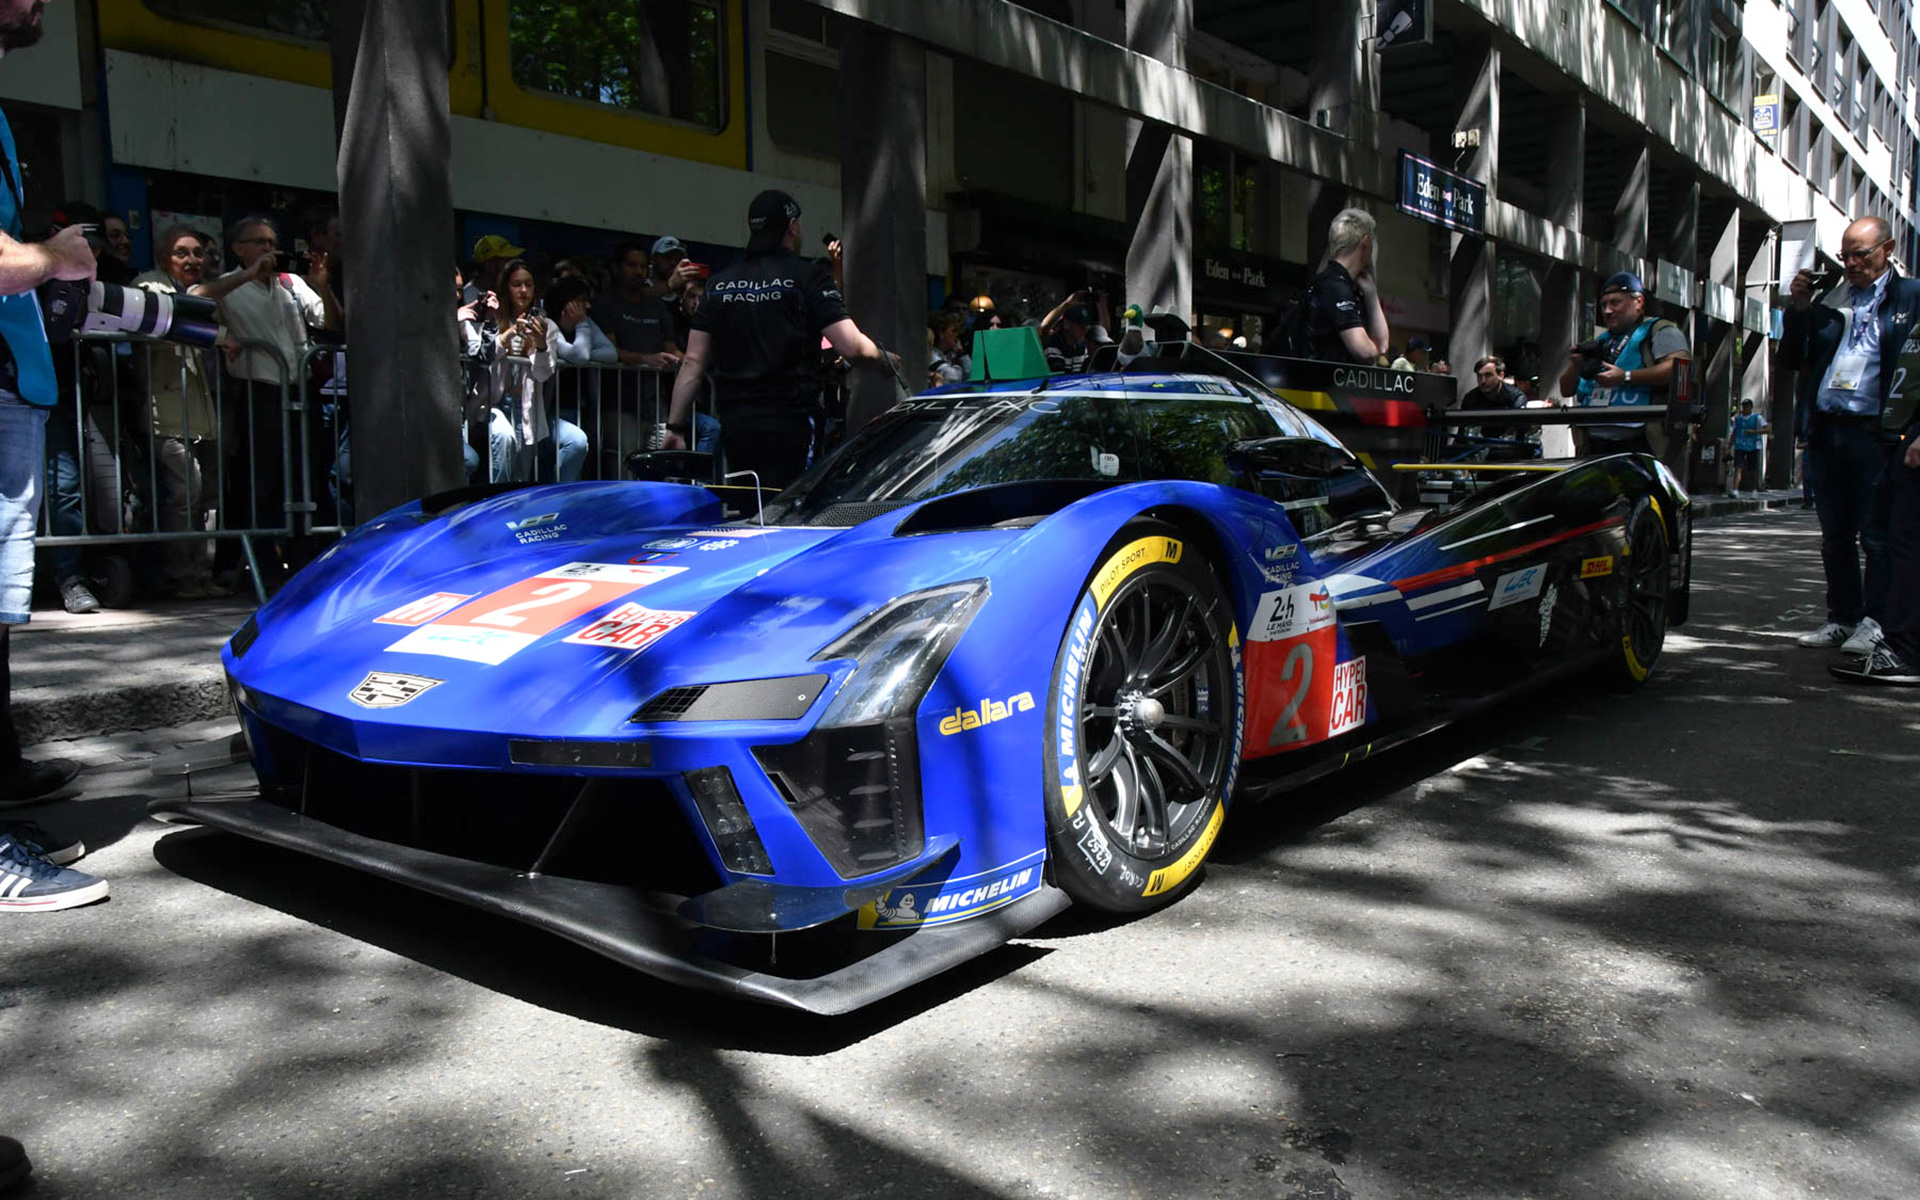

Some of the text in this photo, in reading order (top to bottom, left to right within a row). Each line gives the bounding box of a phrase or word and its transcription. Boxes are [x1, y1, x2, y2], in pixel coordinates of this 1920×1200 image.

[1416, 172, 1474, 215] Eden Park
[715, 278, 795, 291] CADILLAC
[1205, 258, 1266, 288] Eden Park
[722, 291, 781, 302] RACING
[1333, 367, 1414, 394] CADILLAC
[515, 524, 568, 539] CADILLAC
[519, 532, 560, 544] RACING
[1165, 541, 1178, 559] M
[1100, 547, 1146, 594] PILOT SPORT
[1265, 561, 1300, 575] CADILLAC
[1265, 572, 1293, 583] RACING
[1586, 559, 1608, 575] DHL
[469, 582, 593, 627] 2
[612, 606, 694, 625] HYPER
[577, 620, 670, 645] CAR
[1266, 619, 1293, 631] LE MANS
[1061, 607, 1093, 756] MICHELIN
[1335, 660, 1364, 691] HYPER
[1268, 642, 1314, 747] 2
[1332, 683, 1366, 730] CAR
[939, 691, 1035, 736] dallara
[1227, 672, 1246, 799] MICHELIN
[1170, 798, 1212, 851] CADILLAC RACING
[923, 868, 1033, 914] MICHELIN
[1149, 872, 1165, 893] M
